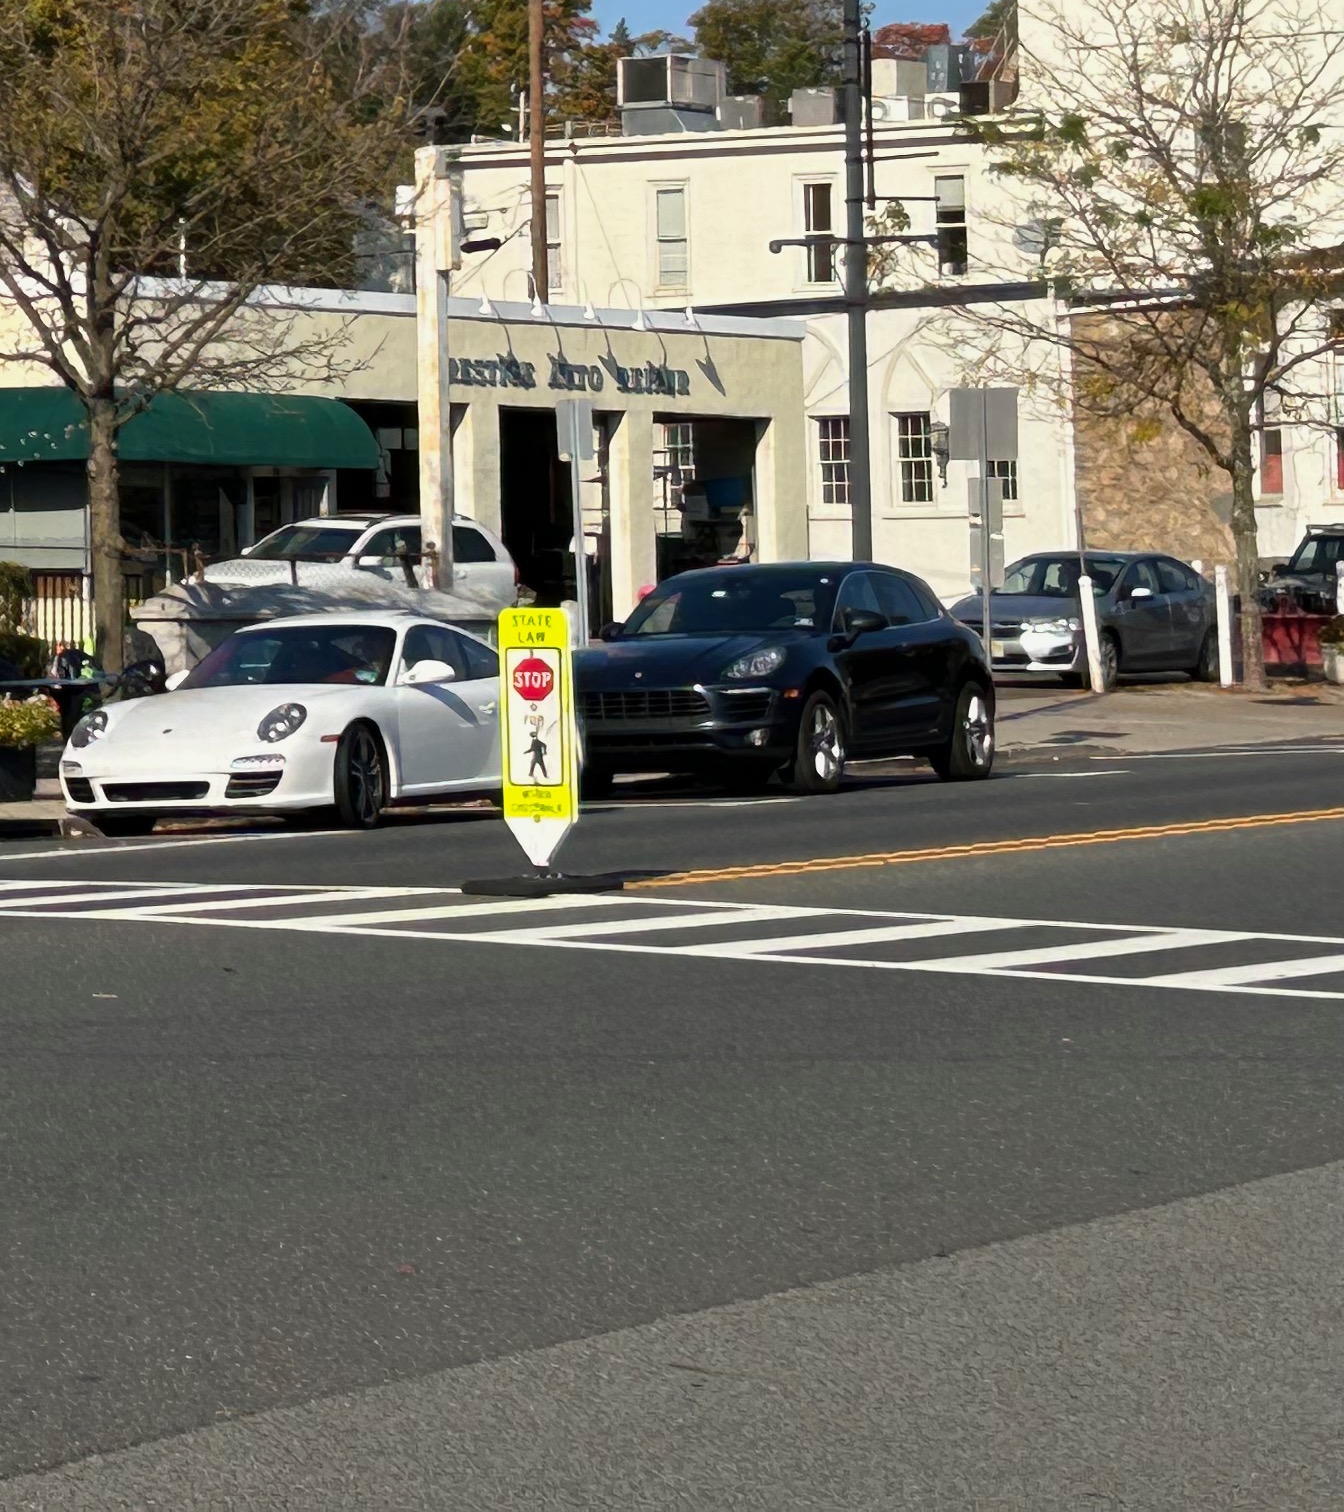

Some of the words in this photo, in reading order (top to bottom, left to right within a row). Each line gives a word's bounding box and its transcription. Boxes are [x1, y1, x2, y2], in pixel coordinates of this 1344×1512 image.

[449, 357, 536, 389] RESTIGE
[512, 614, 552, 628] STATE
[518, 631, 545, 643] LAW
[514, 670, 552, 689] STOP
